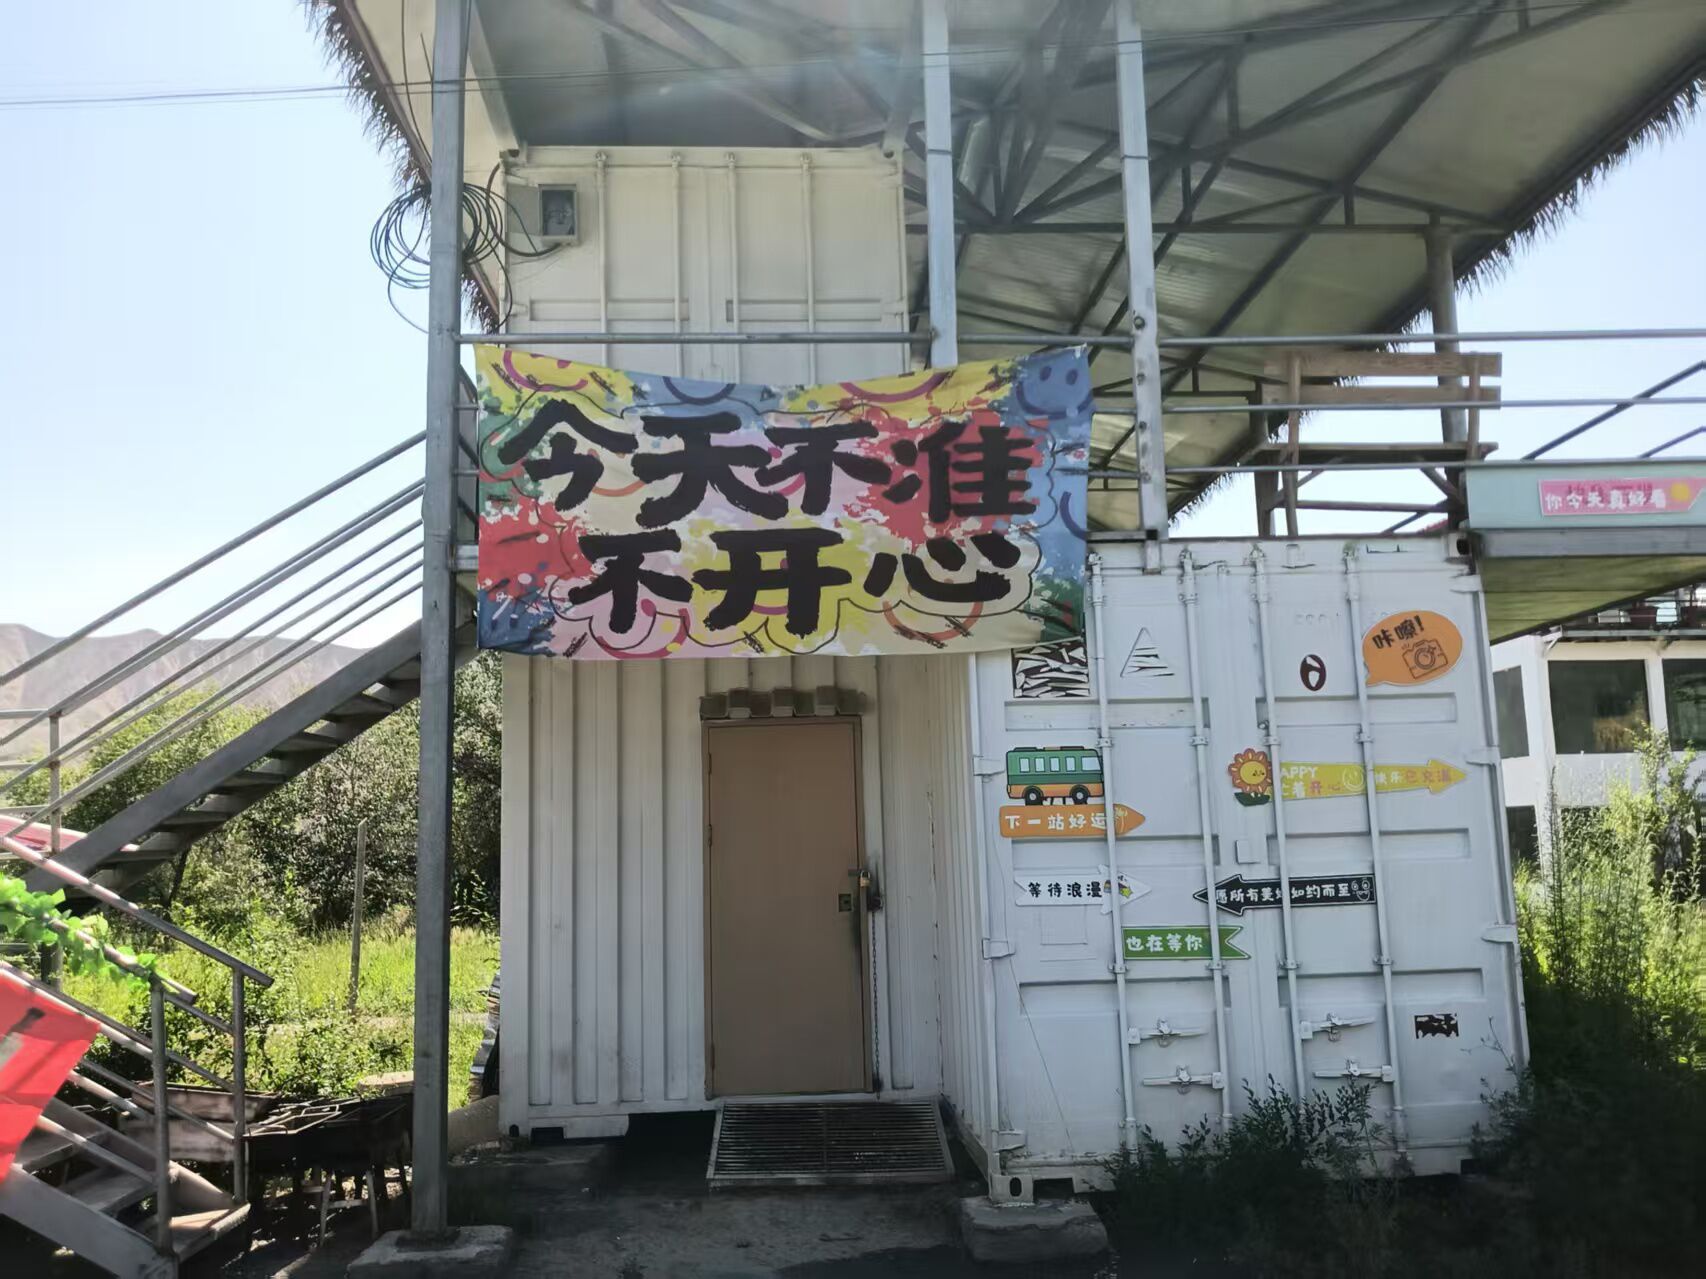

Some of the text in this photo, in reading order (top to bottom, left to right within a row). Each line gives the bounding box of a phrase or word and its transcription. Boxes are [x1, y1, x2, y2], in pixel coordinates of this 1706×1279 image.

[500, 400, 1038, 529] 今天不准
[1545, 488, 1666, 510] 你今天真好看
[567, 529, 1021, 637] 不开心
[1372, 615, 1424, 649] 咔嚓!
[1281, 766, 1319, 779] APPY
[1004, 813, 1107, 831] 下一站好运
[1028, 882, 1102, 898] 等待浪漫
[1126, 933, 1203, 953] 也在等你
